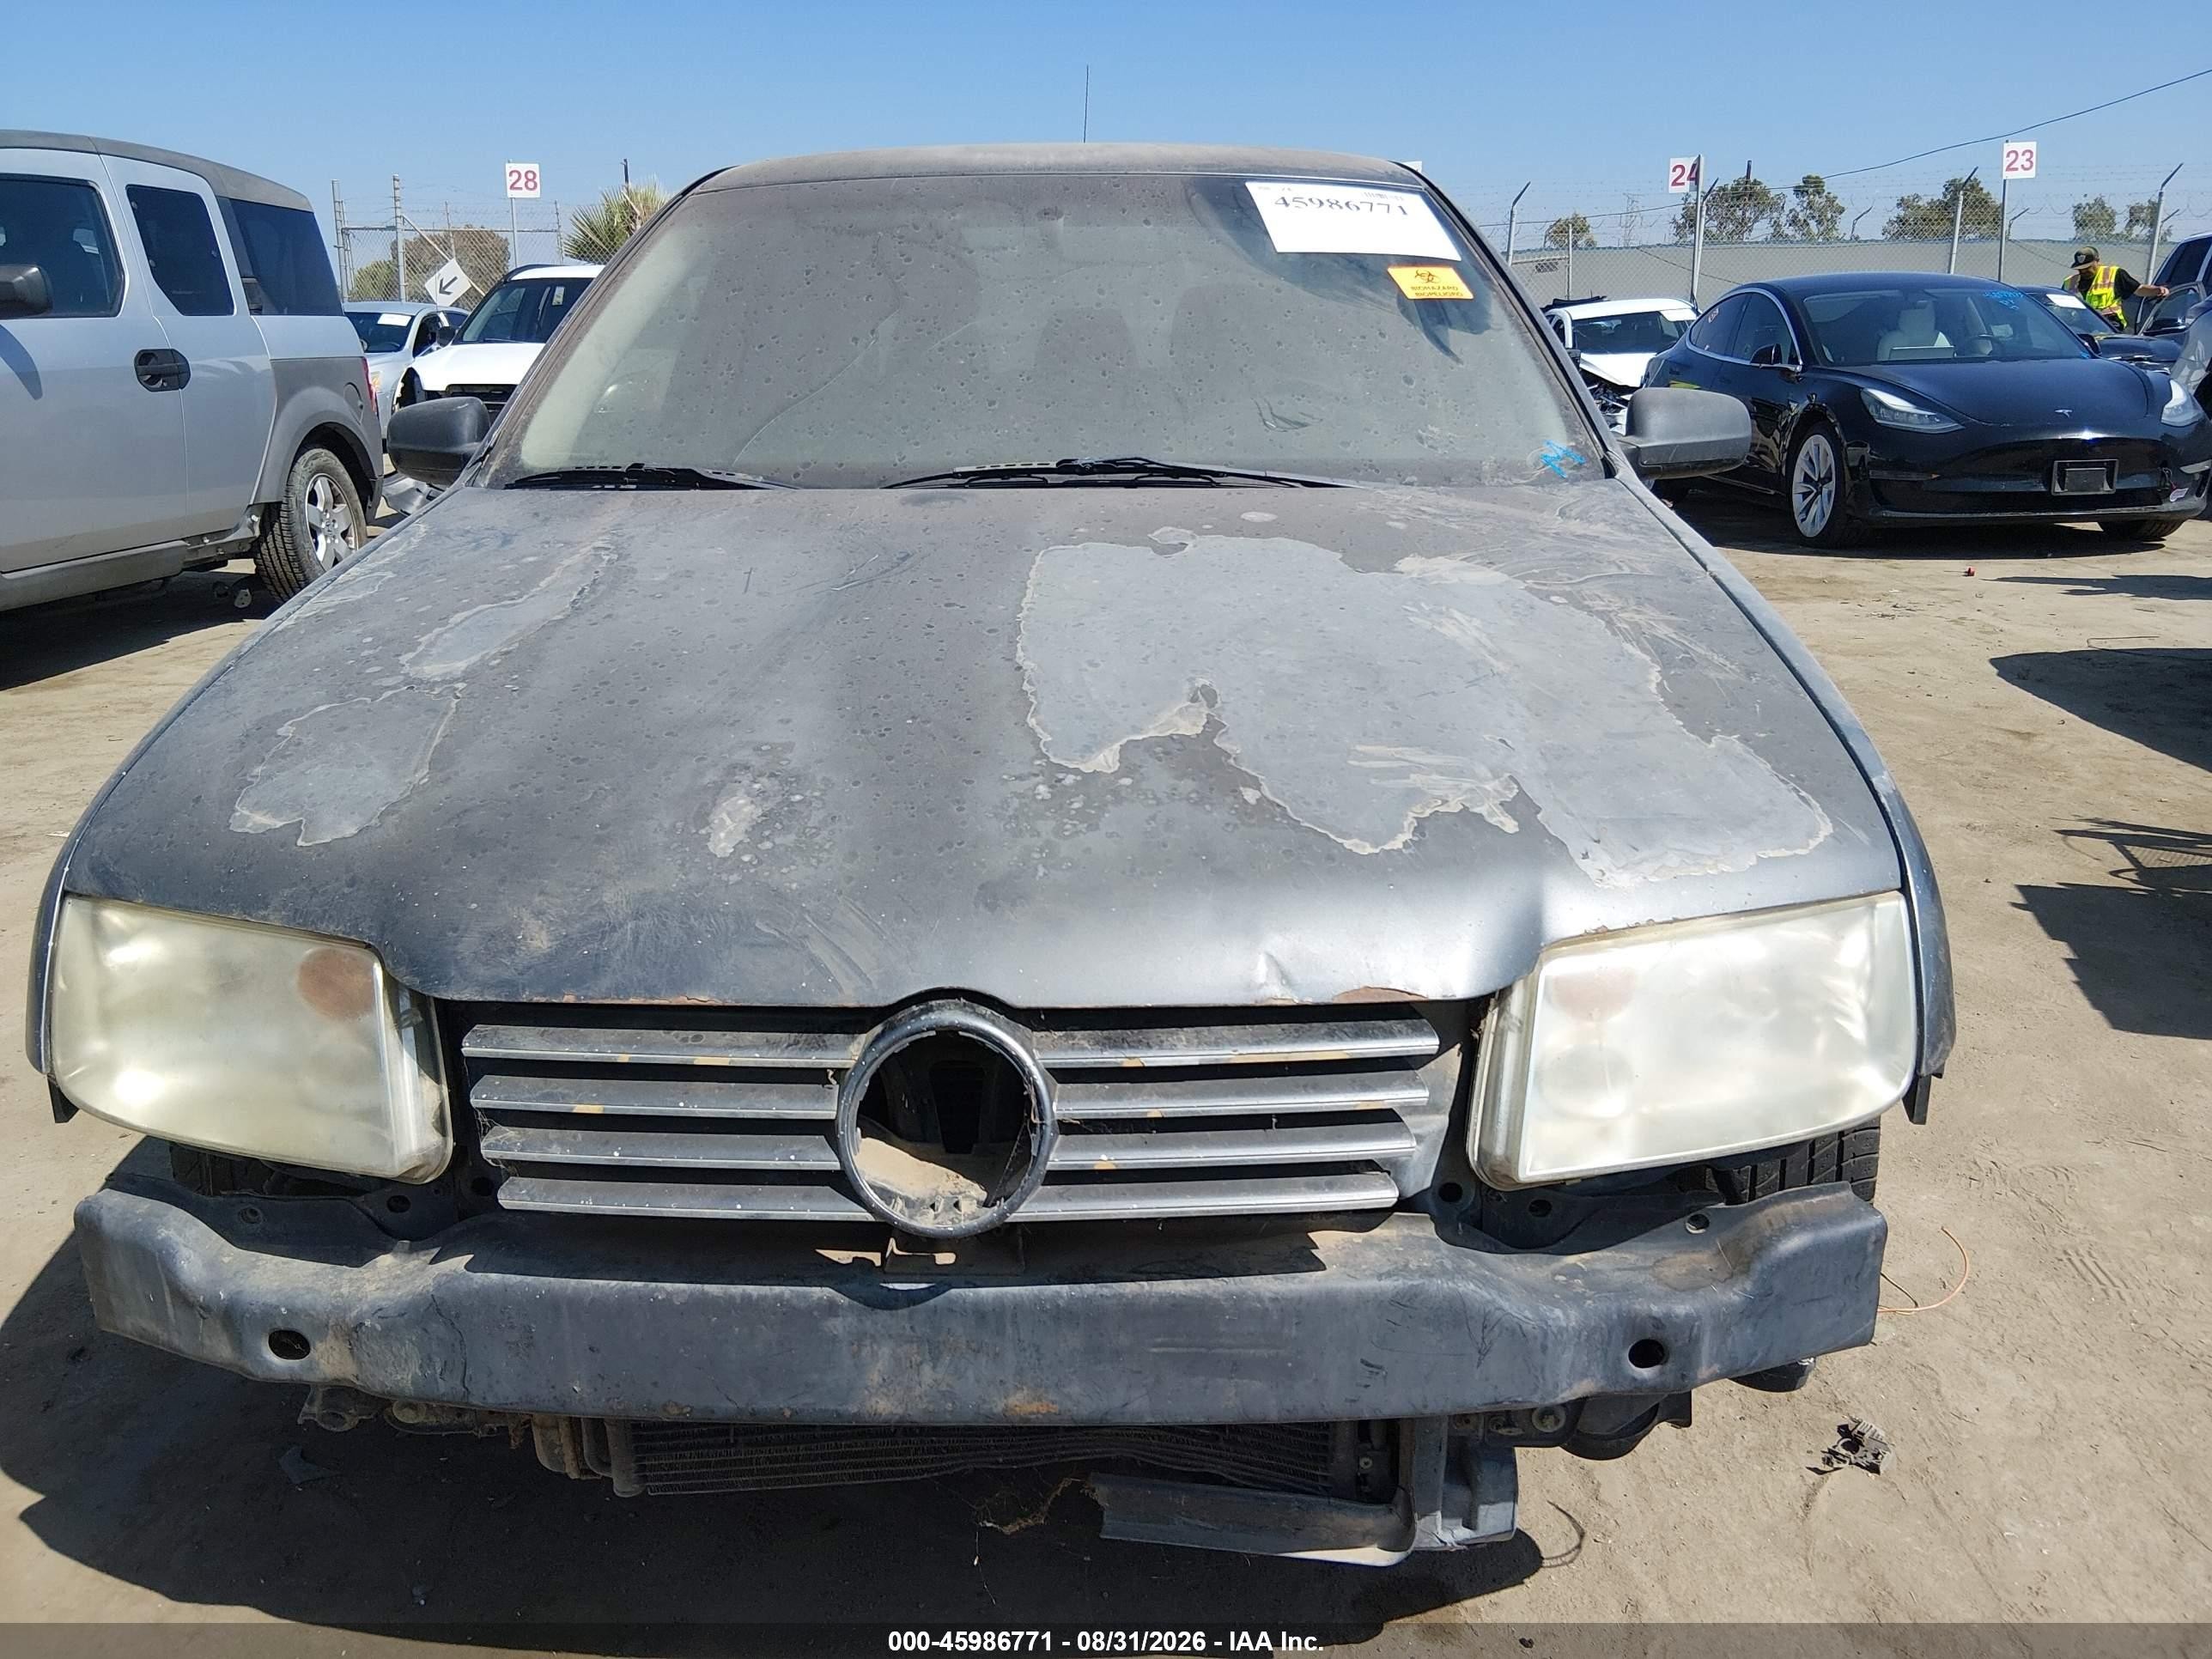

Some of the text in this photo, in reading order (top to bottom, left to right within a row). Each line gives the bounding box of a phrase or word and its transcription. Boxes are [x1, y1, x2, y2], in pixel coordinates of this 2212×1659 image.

[2005, 149, 2033, 171] 23
[508, 169, 538, 191] 28
[1670, 163, 1698, 186] 24
[1274, 196, 1408, 216] 45986771
